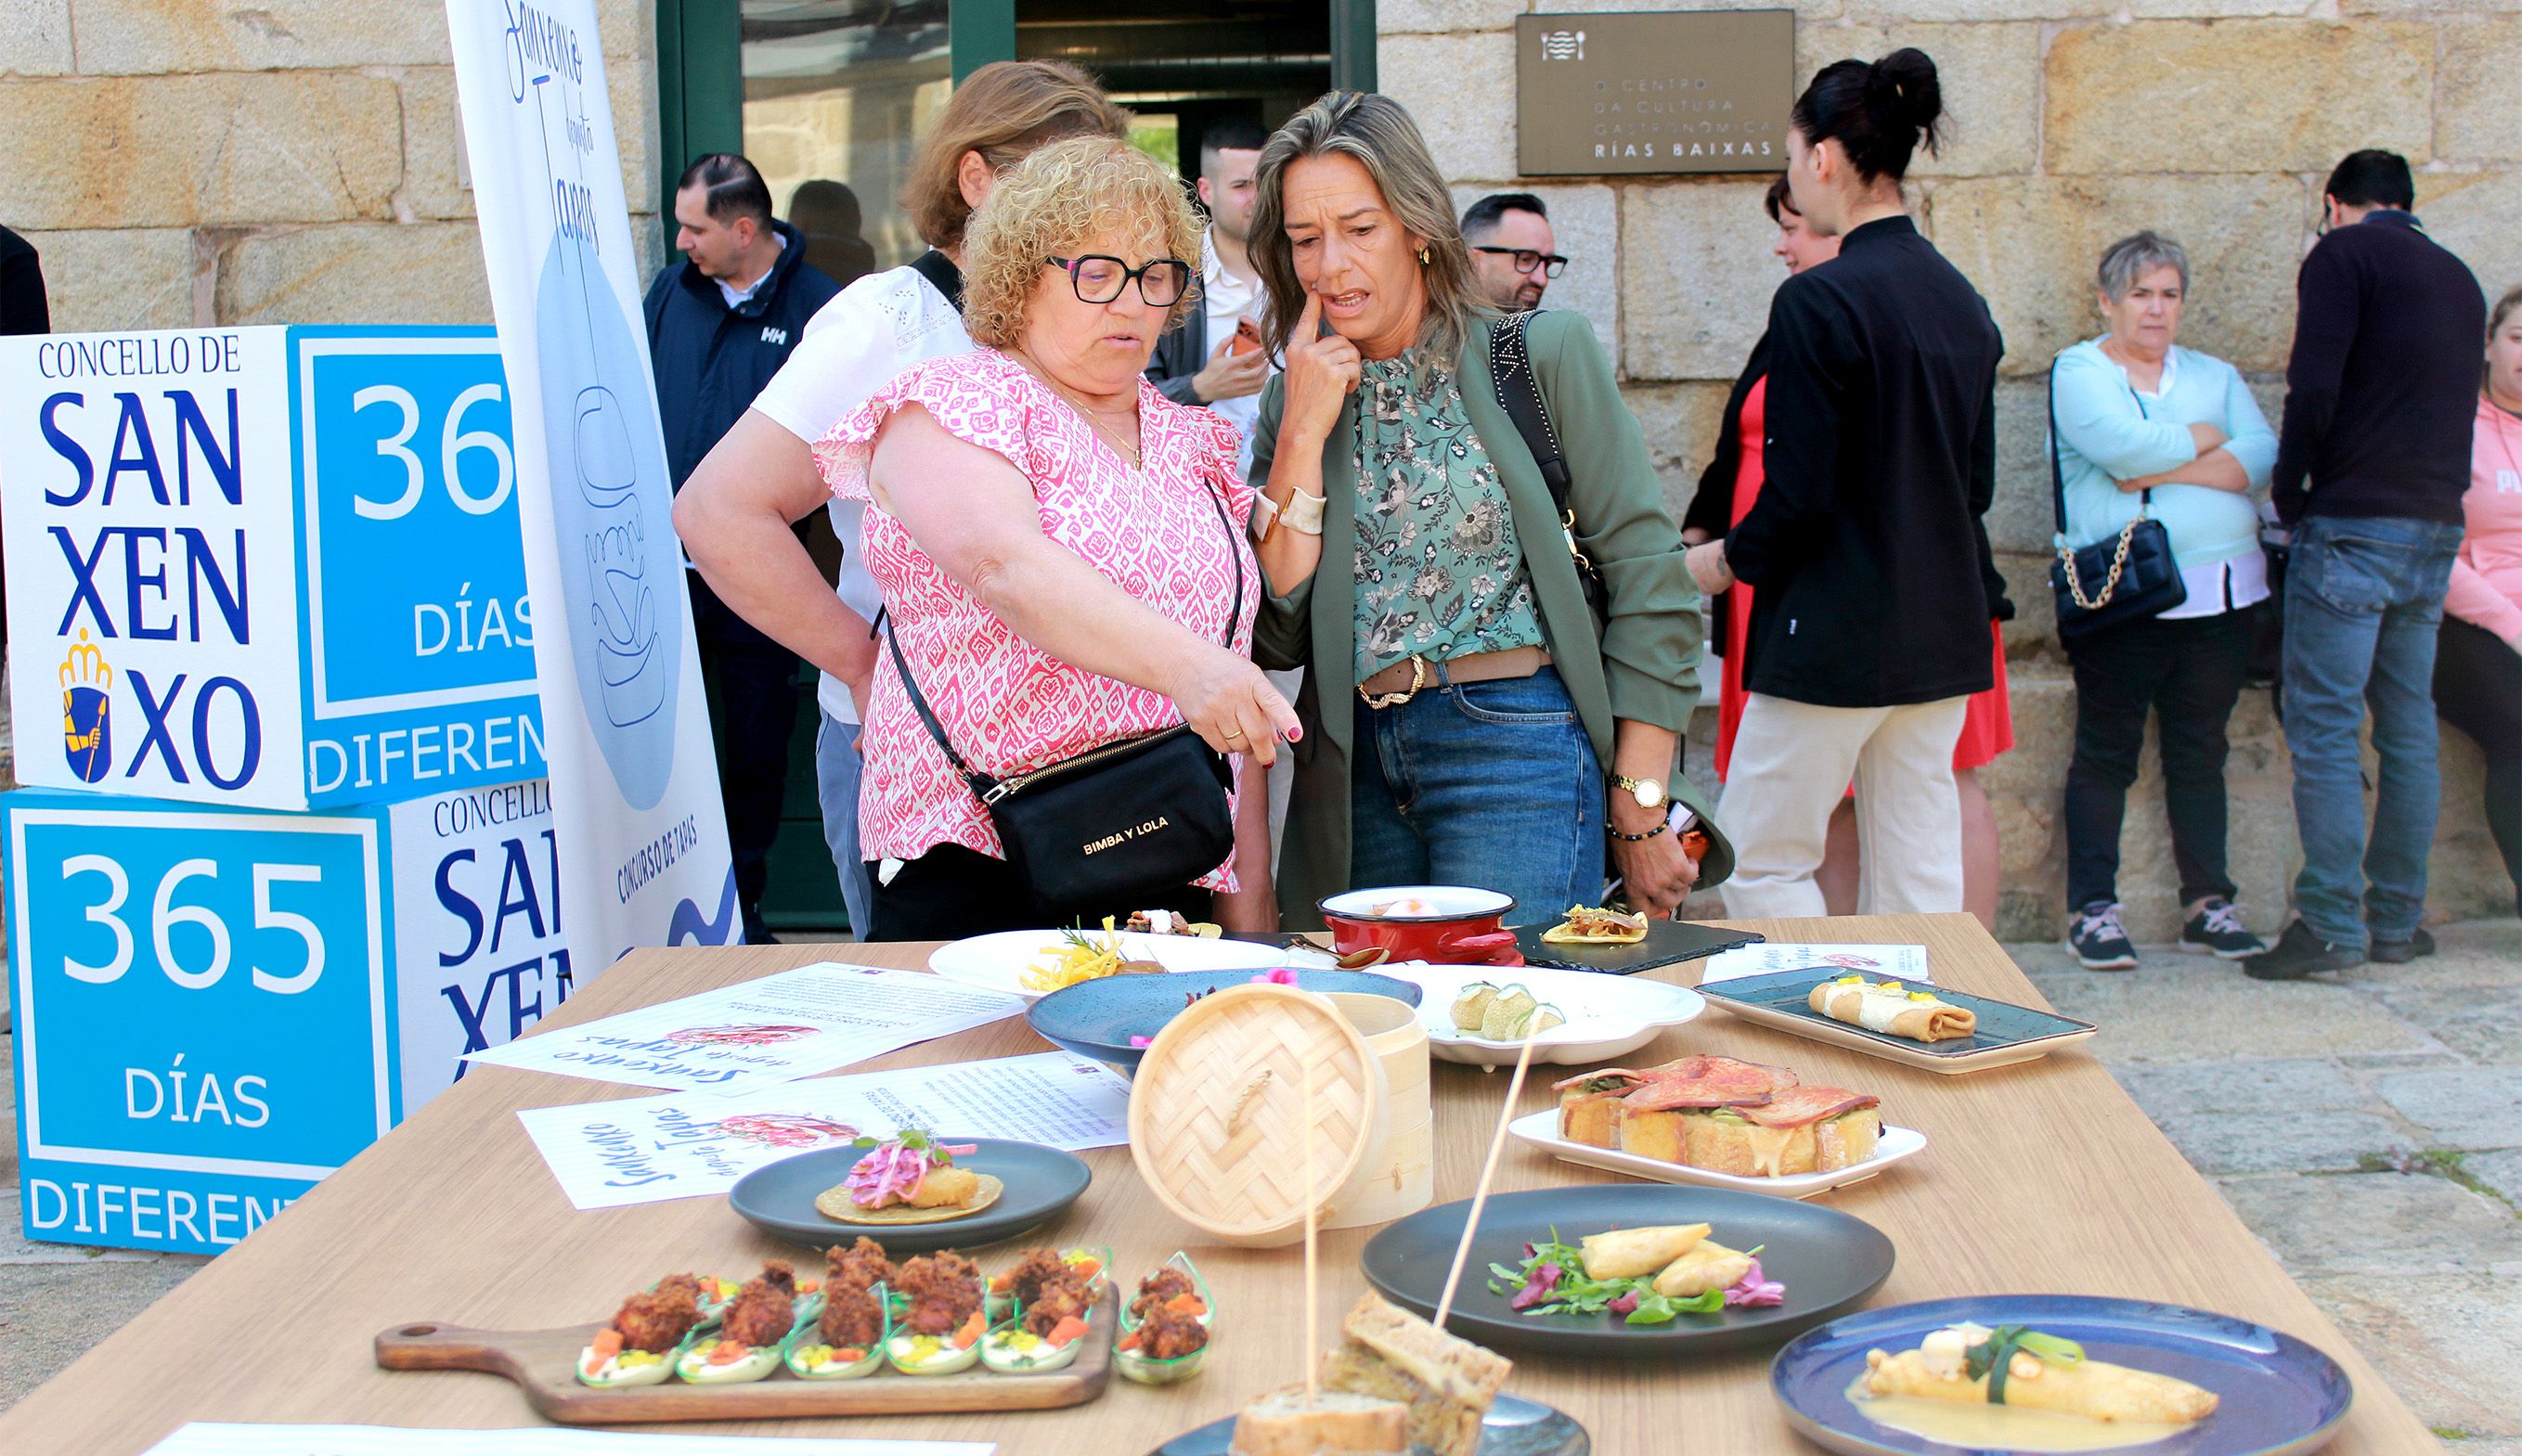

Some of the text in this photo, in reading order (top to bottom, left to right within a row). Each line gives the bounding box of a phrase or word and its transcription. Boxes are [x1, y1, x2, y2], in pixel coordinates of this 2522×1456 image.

[1594, 100, 1734, 115] DA CULTURA
[1622, 78, 1708, 92] CENTRO
[1594, 140, 1772, 158] RÍAS BAIXAS
[39, 335, 241, 380] CONCELLO DE
[40, 388, 242, 507] SAN
[353, 383, 516, 521] 36
[46, 525, 251, 645] XEN
[125, 668, 262, 791] XO
[617, 814, 698, 905] CONCURSO DE TAPAS
[1082, 816, 1169, 856] BIMBA Y LOLA
[61, 854, 327, 994] 365
[125, 1051, 270, 1127] DÍAS
[553, 1051, 750, 1084] Sanxenxo
[581, 1123, 678, 1187] Sanxenxo
